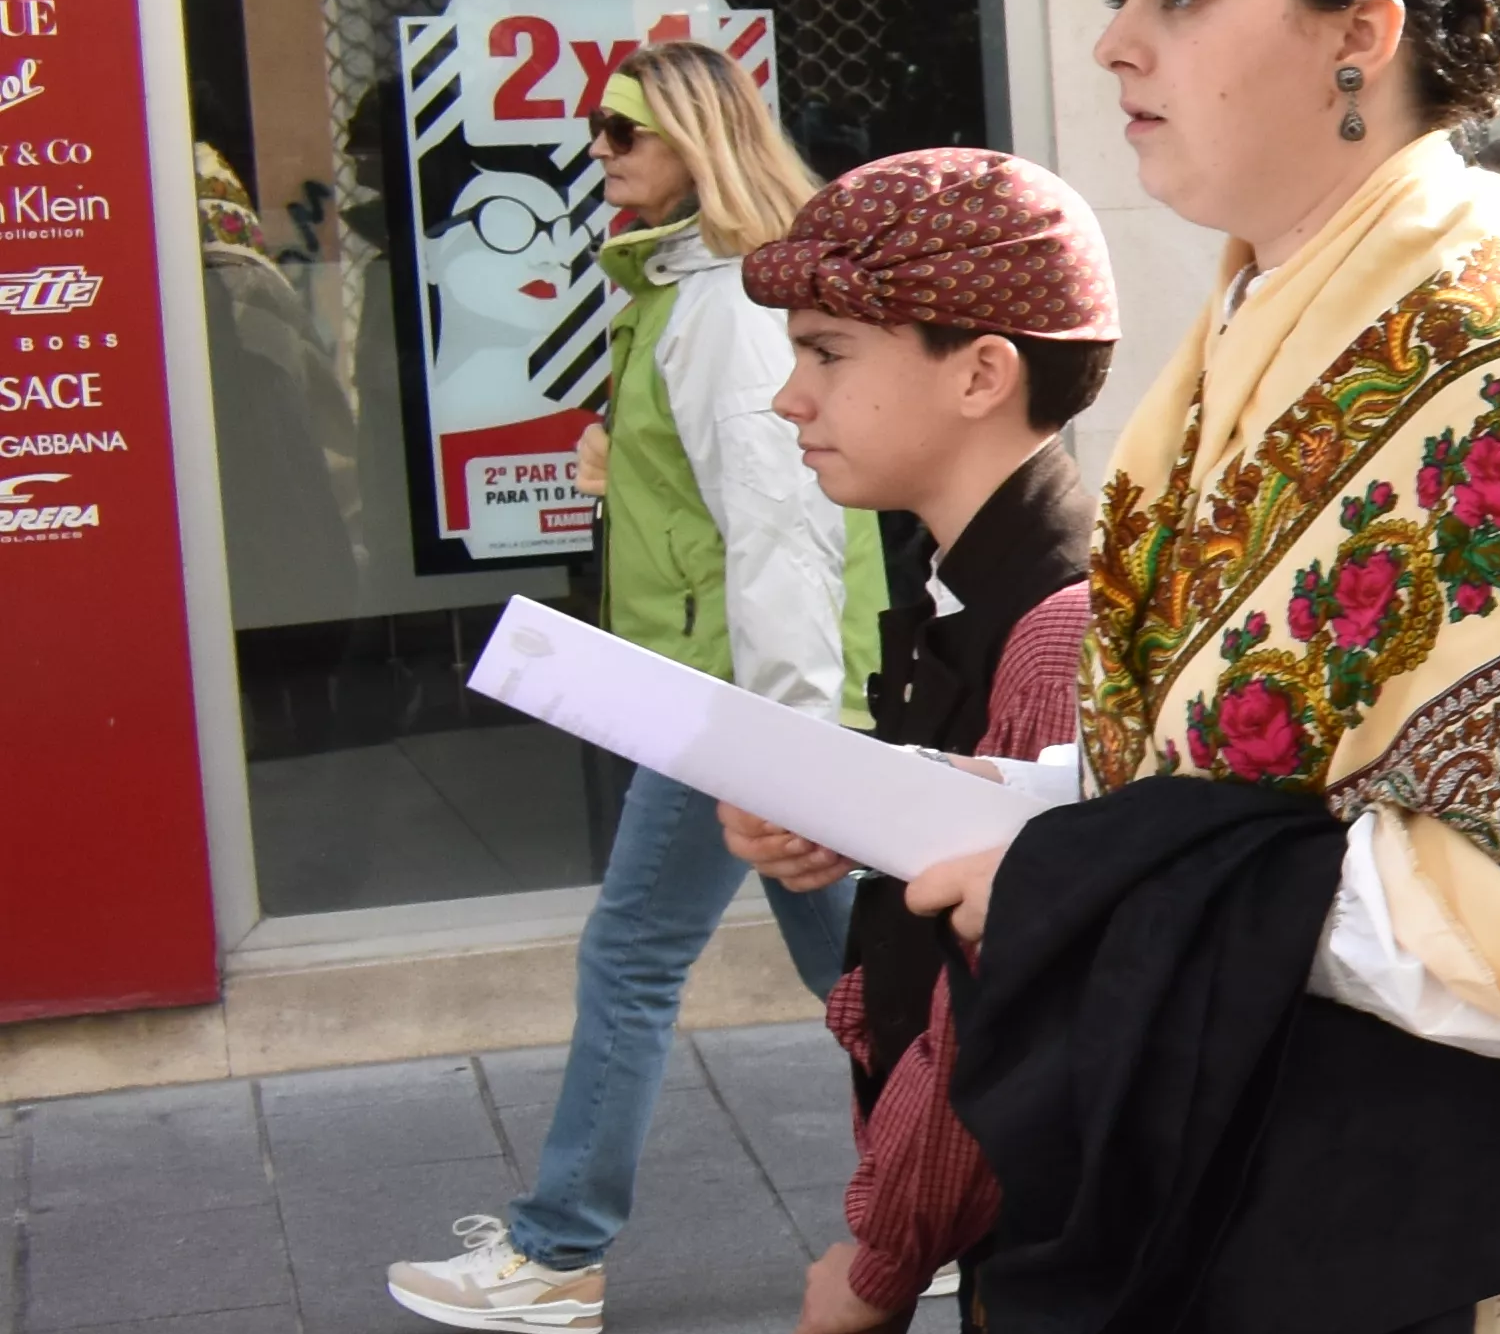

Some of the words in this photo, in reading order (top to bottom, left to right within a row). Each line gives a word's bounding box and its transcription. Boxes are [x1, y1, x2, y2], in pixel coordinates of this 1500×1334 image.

[15, 185, 110, 223] Klein
[0, 430, 128, 458] GABBANA
[515, 463, 557, 483] PAR
[485, 489, 529, 505] PARA
[535, 488, 549, 502] TI
[554, 486, 565, 500] O
